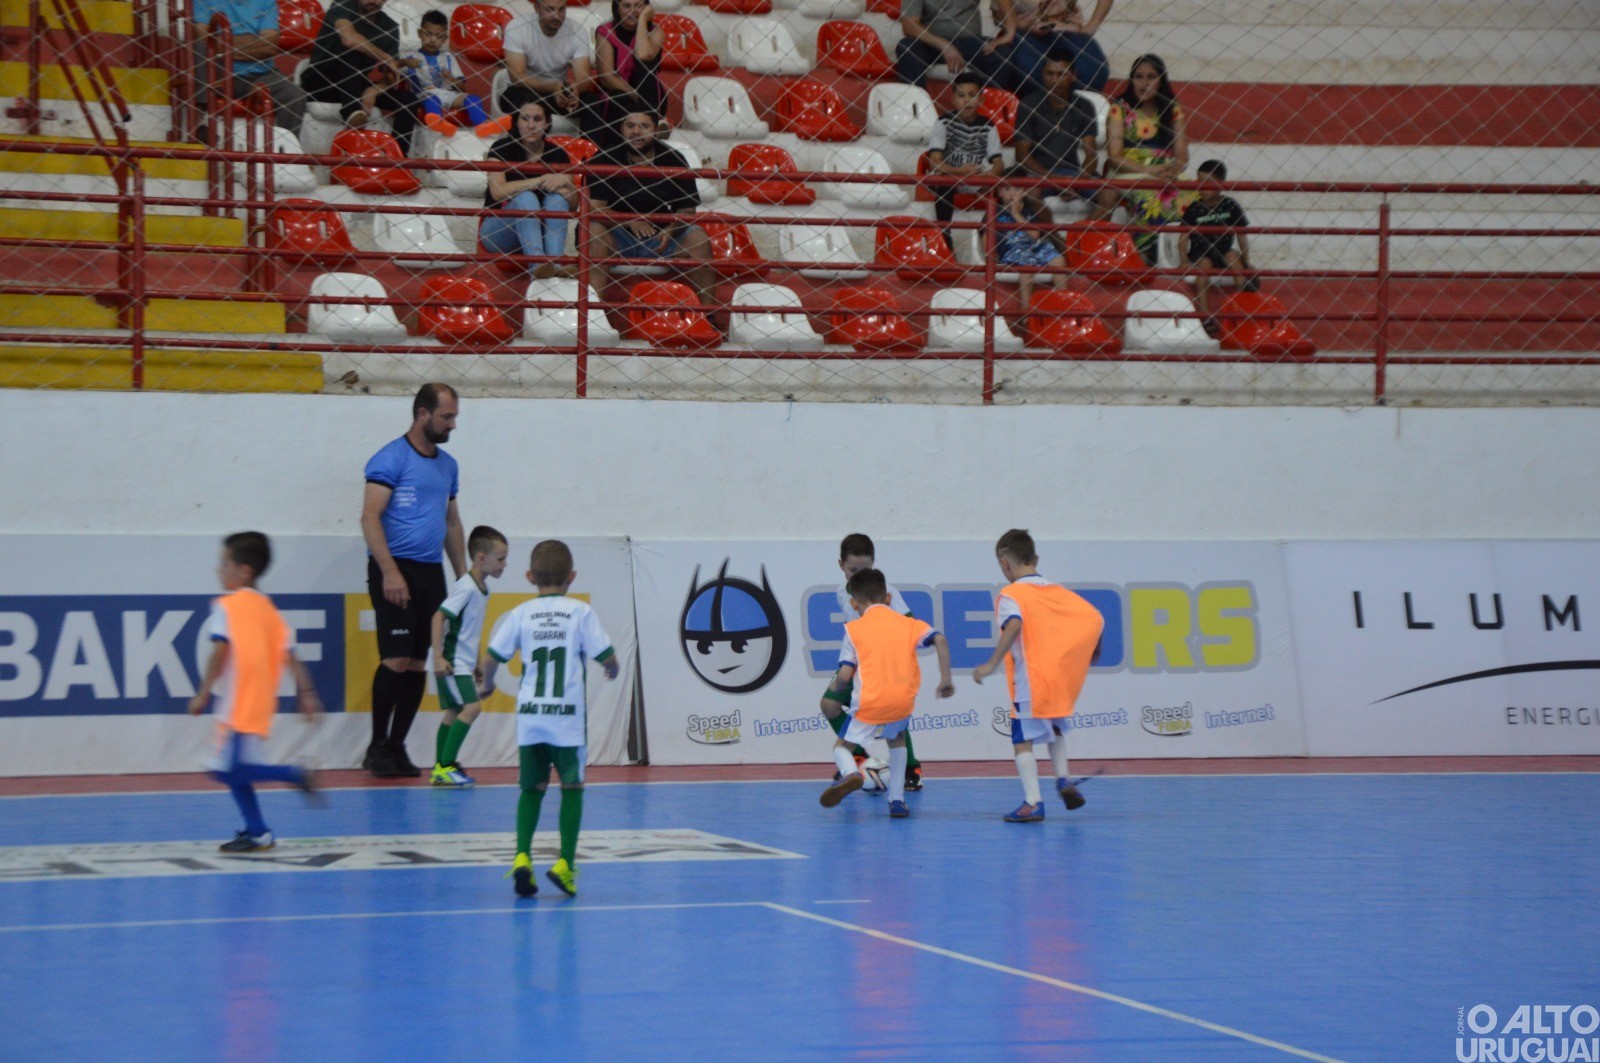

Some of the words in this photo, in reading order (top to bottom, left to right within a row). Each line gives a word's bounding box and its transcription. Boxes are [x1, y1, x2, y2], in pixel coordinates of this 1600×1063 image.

[1353, 591, 1582, 631] ILUM
[533, 630, 566, 640] GUARANI
[0, 609, 326, 699] BAKF
[531, 646, 566, 698] 11
[687, 709, 741, 735] Speed
[753, 712, 829, 737] Internet
[909, 709, 980, 732] Internet
[1067, 708, 1130, 729] nternet
[1142, 702, 1193, 727] Speed
[1158, 719, 1193, 732] FIBRA
[1205, 704, 1275, 728] Internet
[705, 728, 741, 741] FIBRA
